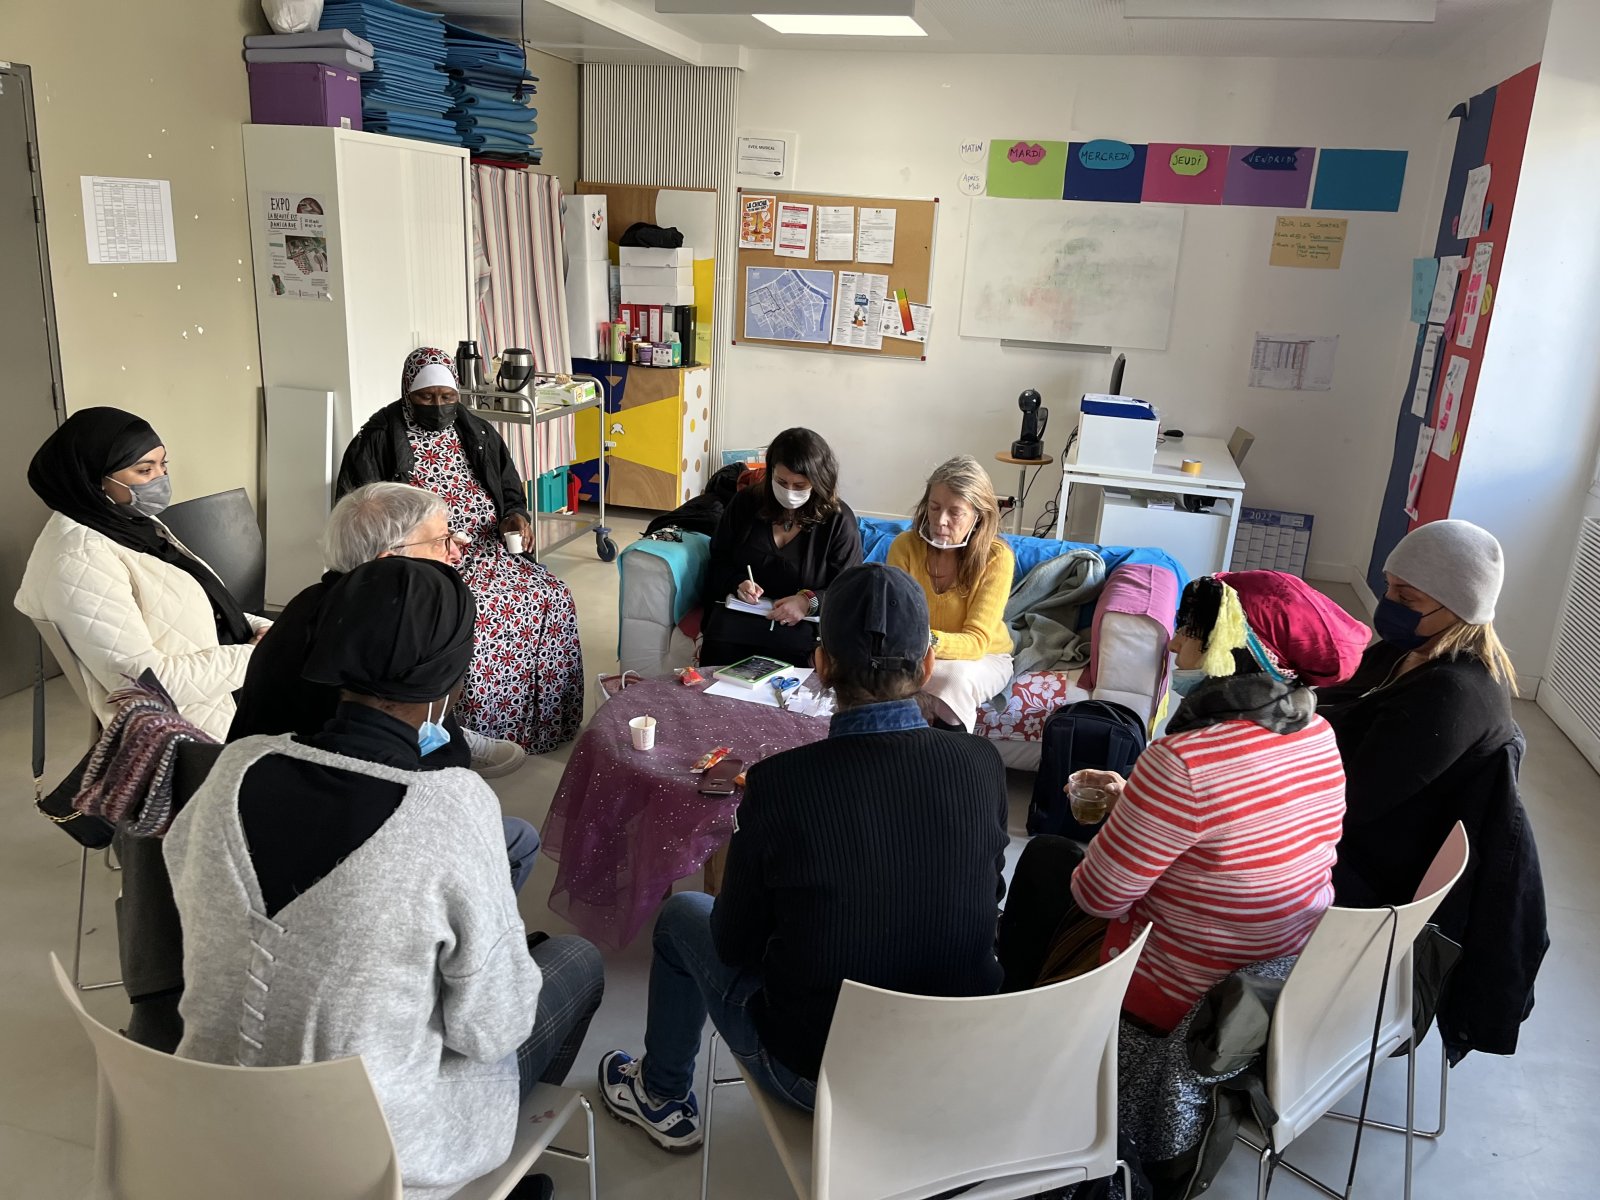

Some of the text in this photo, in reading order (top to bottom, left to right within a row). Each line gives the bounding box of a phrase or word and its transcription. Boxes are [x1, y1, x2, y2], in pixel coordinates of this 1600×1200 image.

[961, 142, 983, 154] MATIN
[270, 198, 290, 211] EXPO
[1248, 511, 1272, 521] 2022
